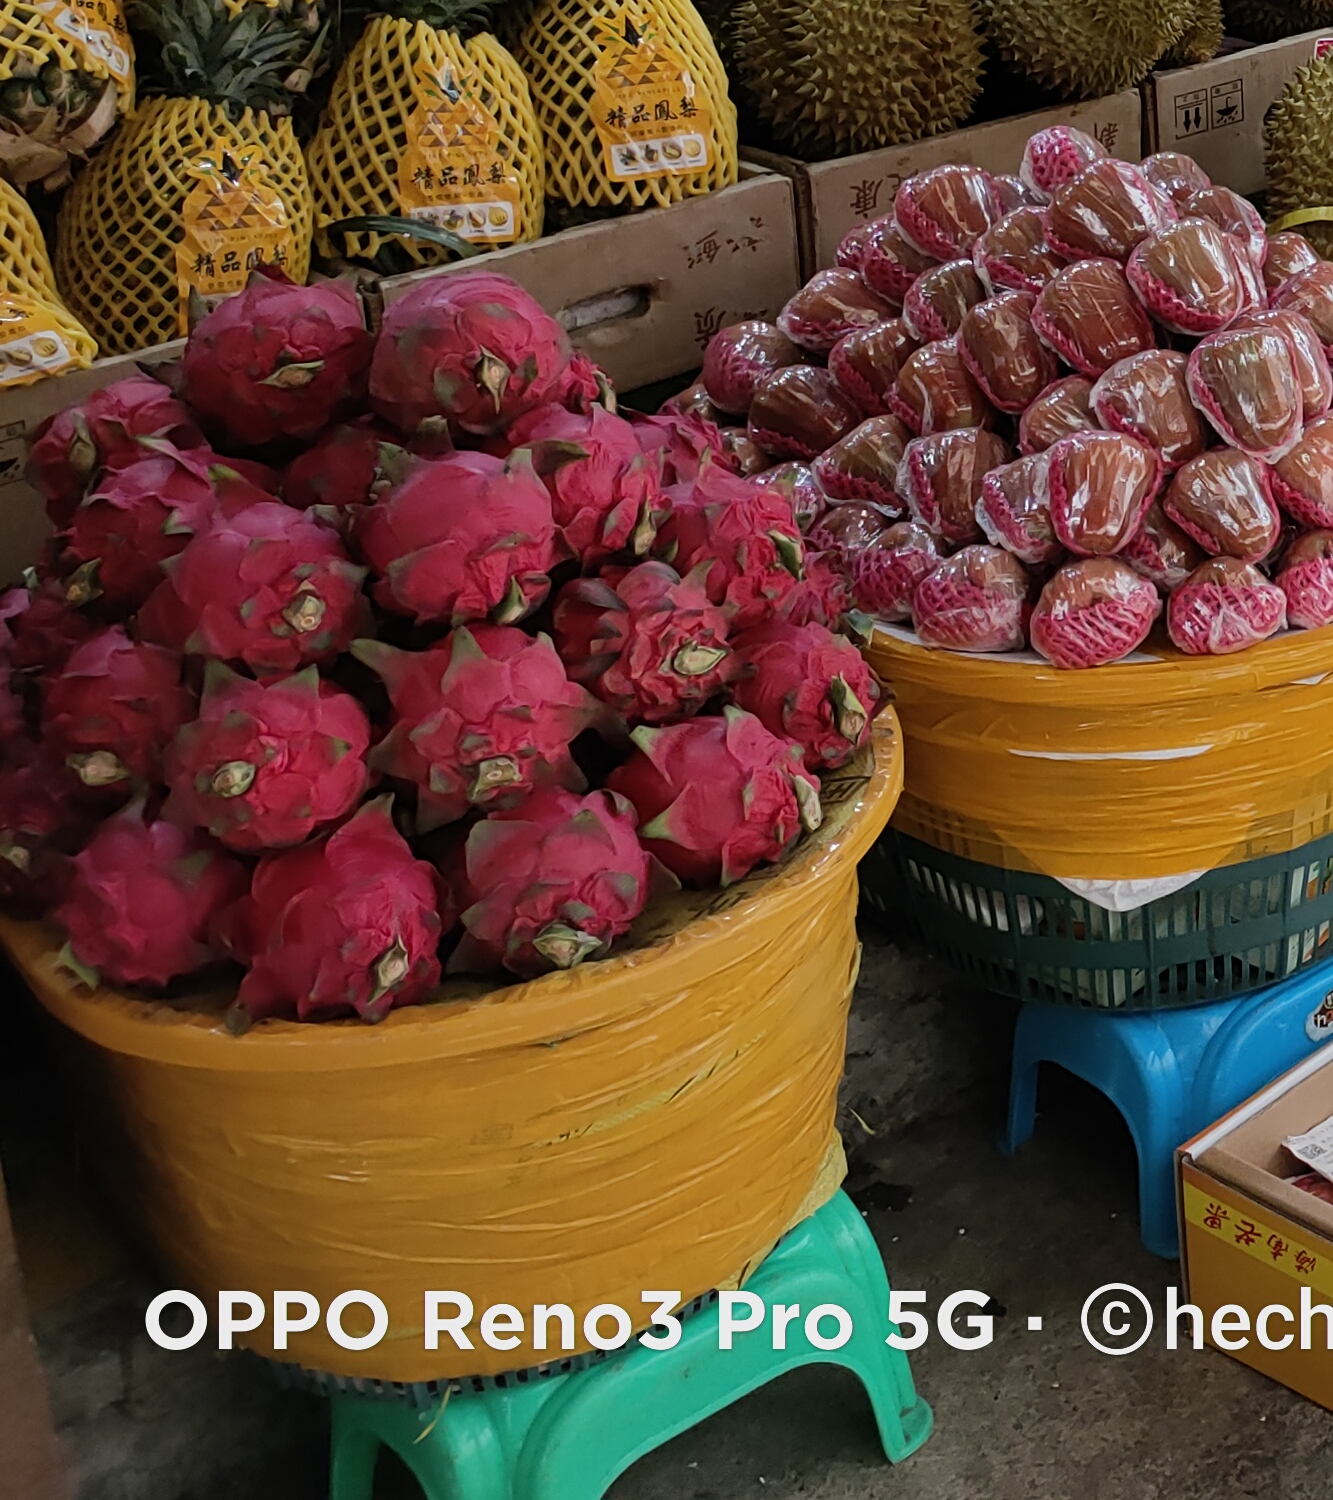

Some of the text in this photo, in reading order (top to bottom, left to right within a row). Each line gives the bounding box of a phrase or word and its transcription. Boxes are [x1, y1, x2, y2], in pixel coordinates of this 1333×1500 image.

[604, 97, 699, 129] 精品鳳梨
[411, 161, 506, 190] 精品鳳梨
[1203, 1202, 1316, 1274] 海南芒果
